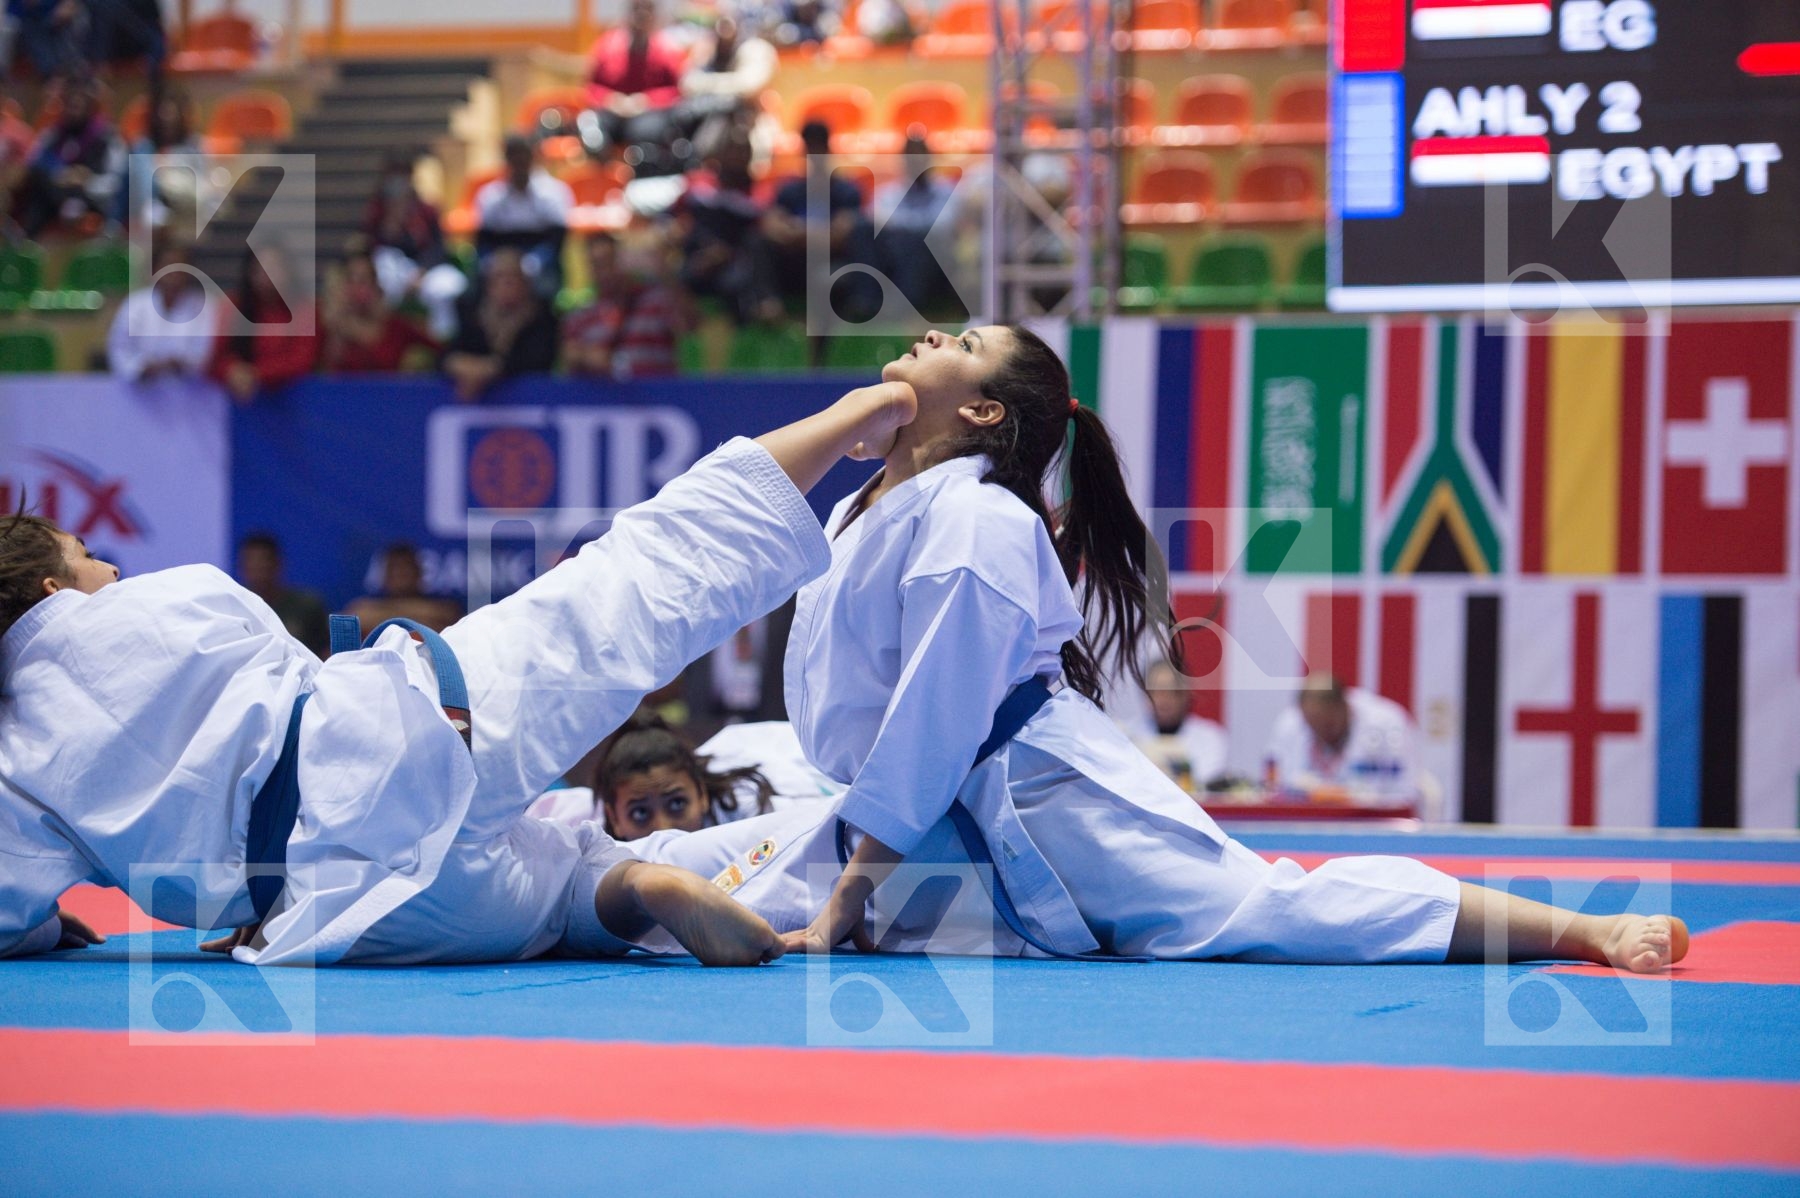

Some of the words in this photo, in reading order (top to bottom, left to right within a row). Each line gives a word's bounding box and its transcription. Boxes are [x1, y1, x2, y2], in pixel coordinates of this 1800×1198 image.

[1559, 0, 1656, 51] EG
[1412, 83, 1590, 137] AHLY
[1599, 81, 1641, 133] 2
[1556, 142, 1782, 200] EGYPT
